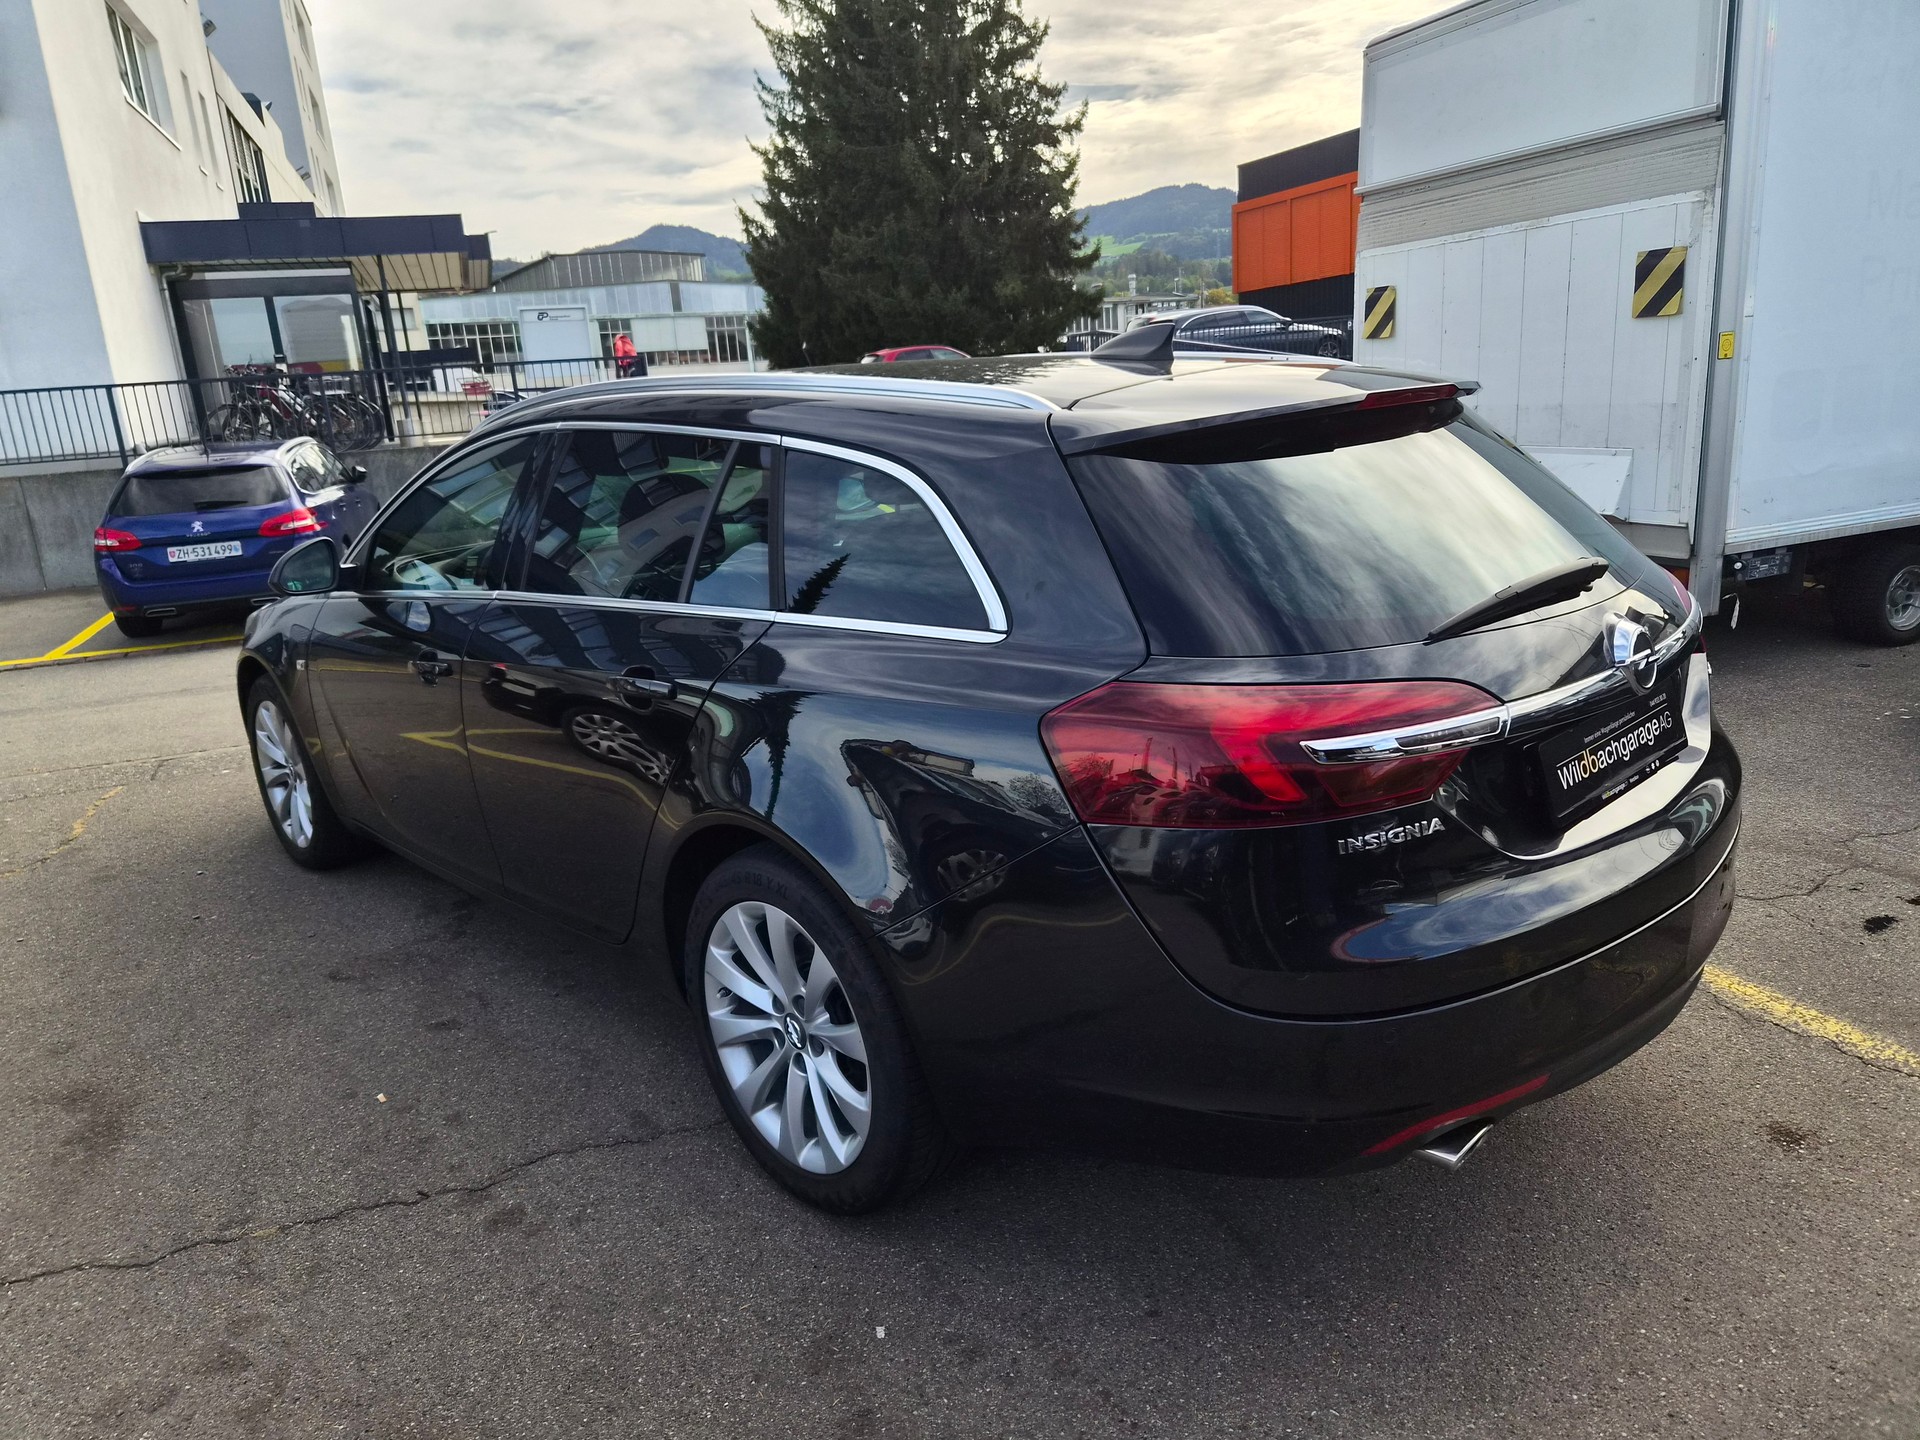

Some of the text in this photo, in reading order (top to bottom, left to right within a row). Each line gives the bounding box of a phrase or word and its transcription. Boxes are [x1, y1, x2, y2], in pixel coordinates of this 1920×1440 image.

[1557, 711, 1673, 790] Wildbachgarage AG
[1337, 817, 1446, 855] INSIGNIA
